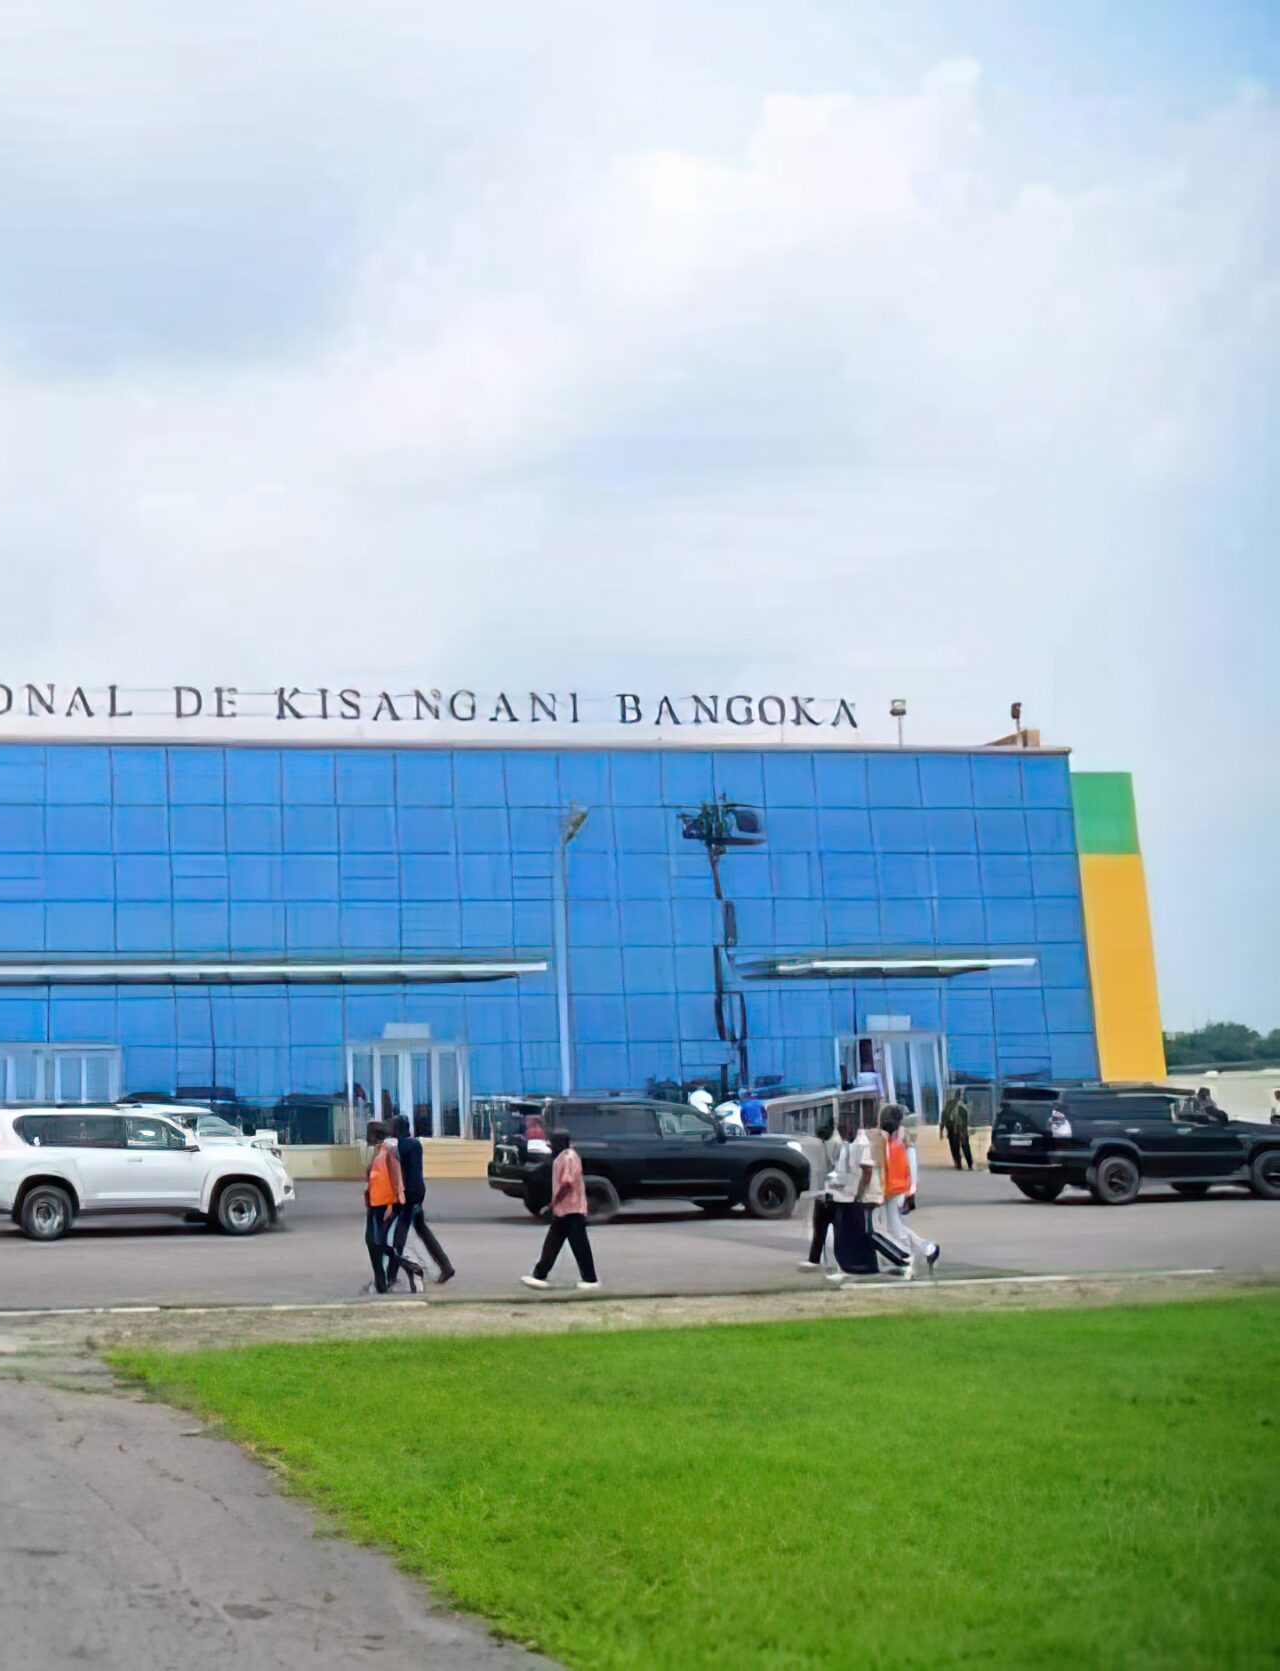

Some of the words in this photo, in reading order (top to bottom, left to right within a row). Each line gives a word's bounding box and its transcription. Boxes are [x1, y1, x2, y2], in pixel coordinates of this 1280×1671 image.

[173, 685, 238, 719] DE
[276, 686, 581, 723] KISANGANI
[615, 693, 858, 728] BANGOKA
